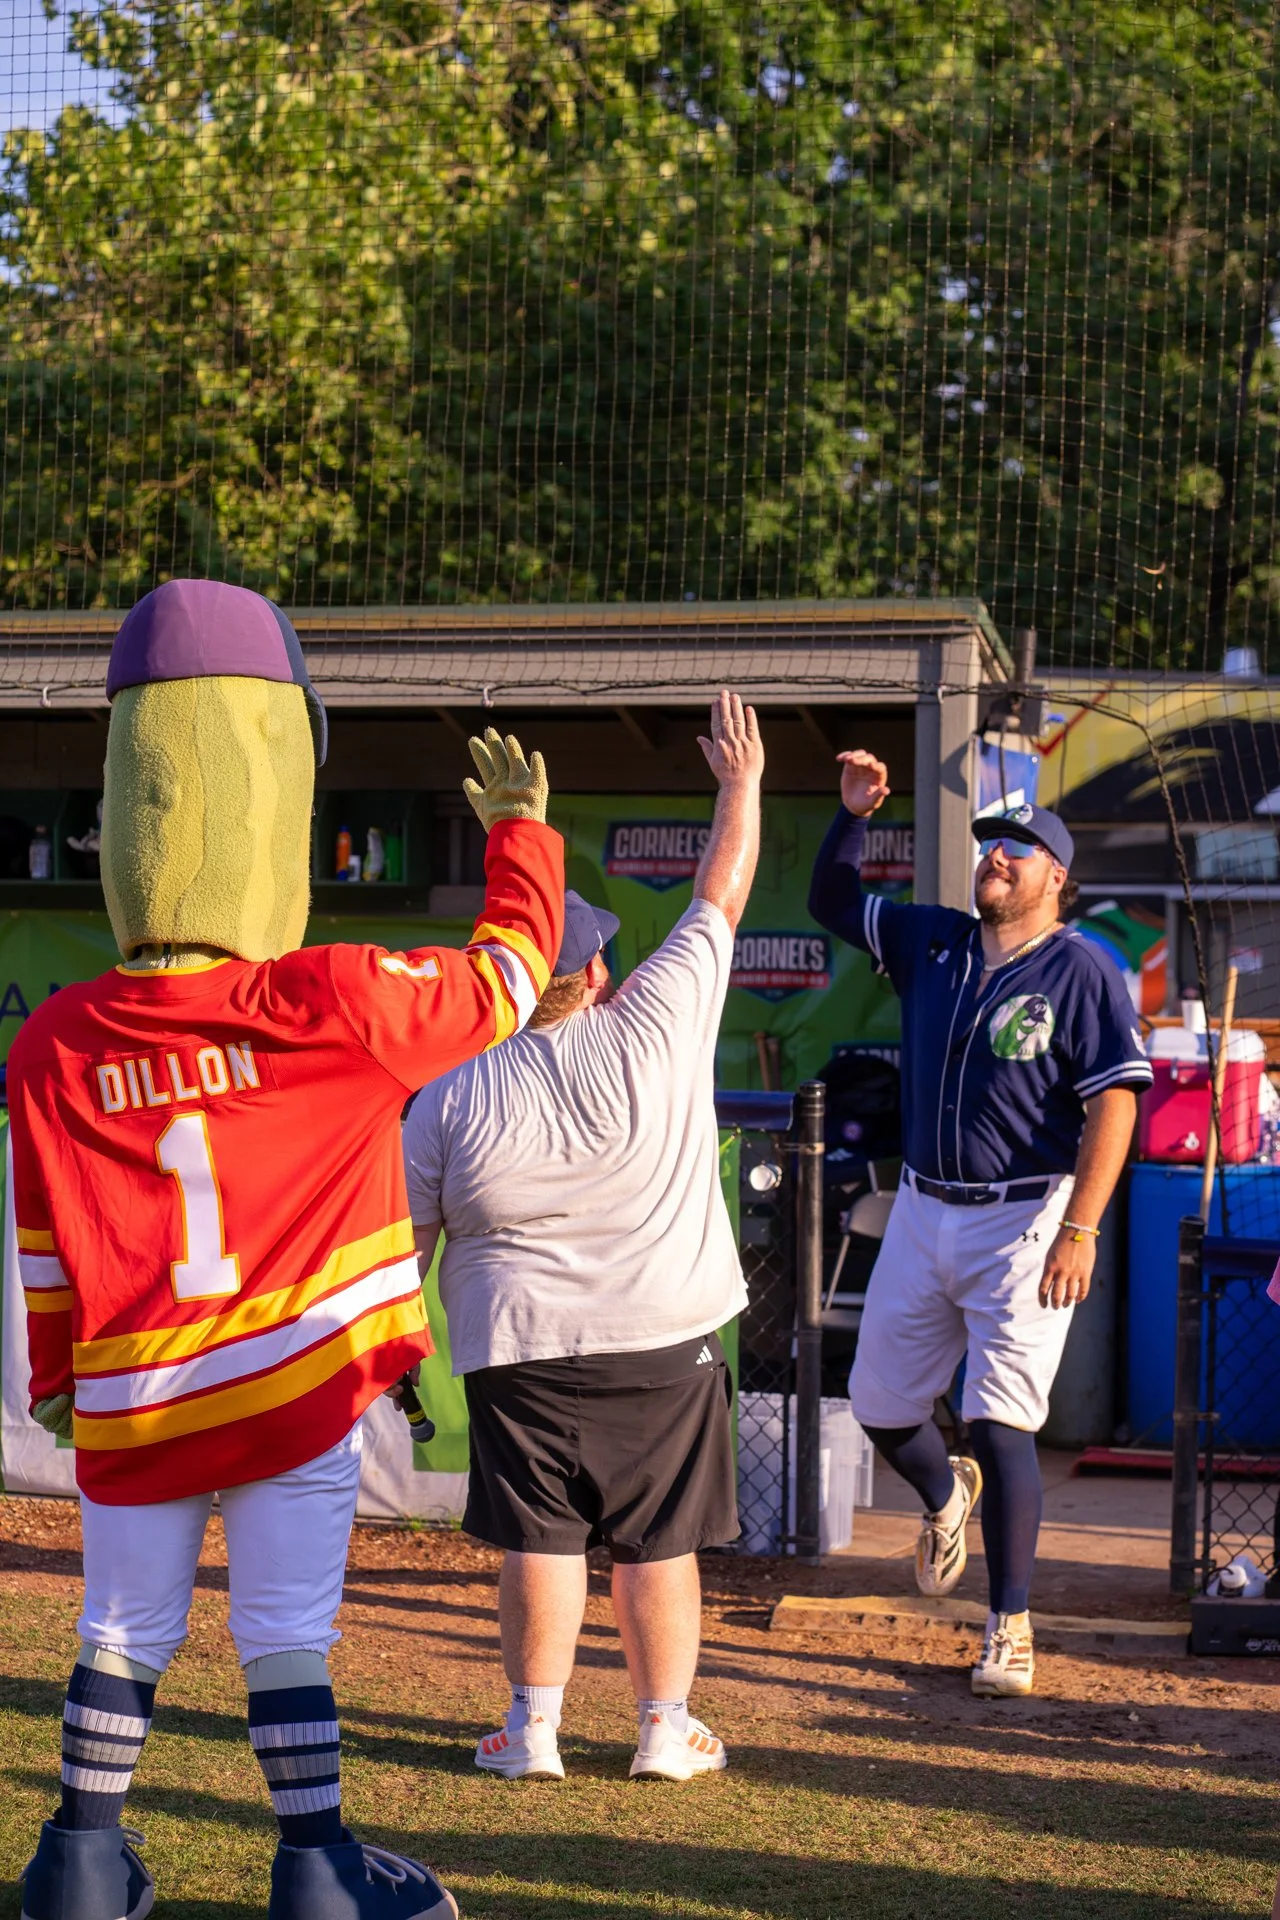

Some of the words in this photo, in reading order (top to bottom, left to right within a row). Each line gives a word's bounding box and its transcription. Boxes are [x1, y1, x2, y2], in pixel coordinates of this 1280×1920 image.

[614, 827, 712, 859] CORNEL'S
[96, 1040, 260, 1114] DILLON
[154, 1110, 241, 1304] 1
